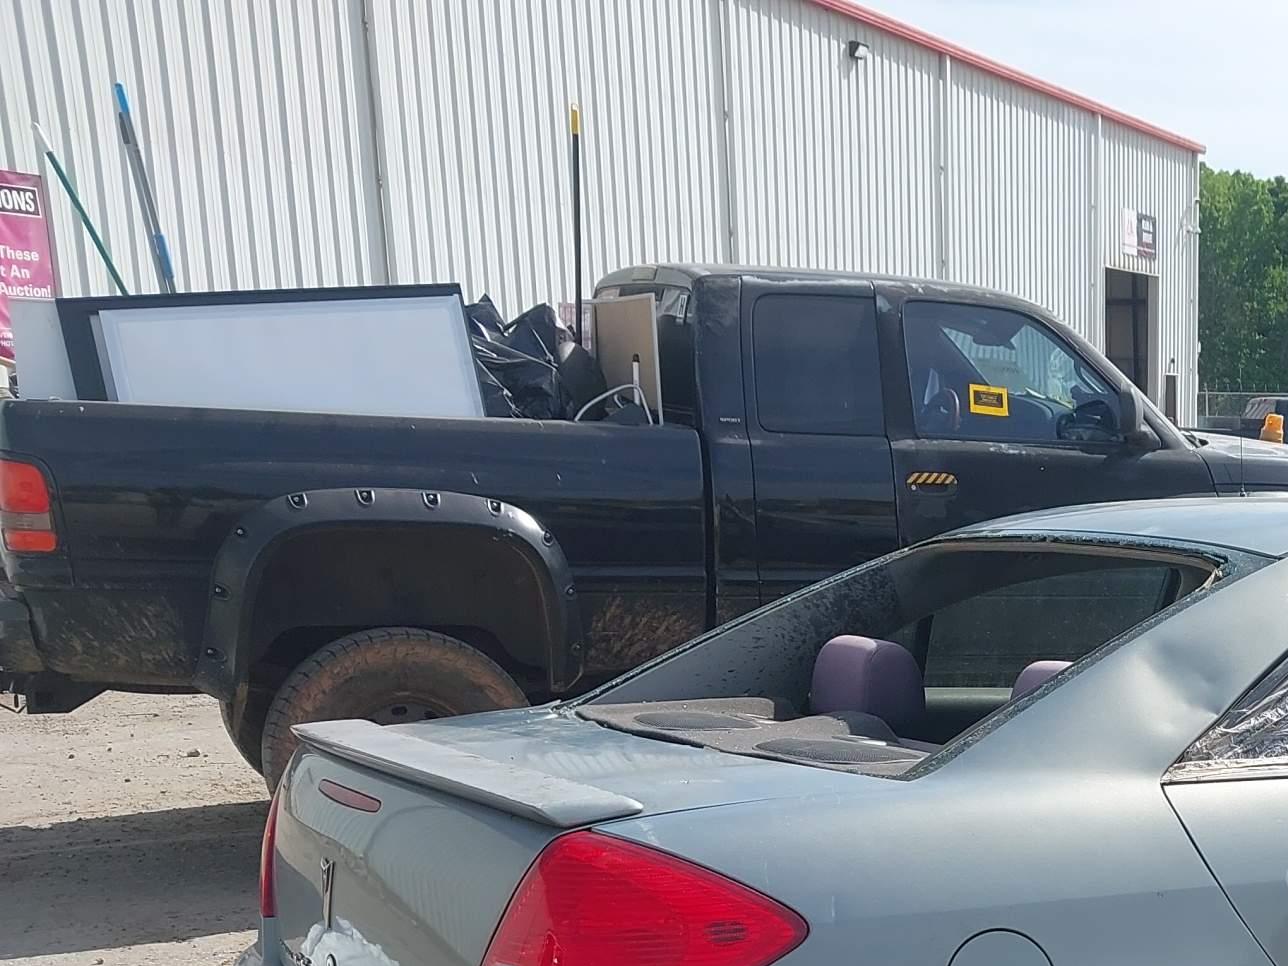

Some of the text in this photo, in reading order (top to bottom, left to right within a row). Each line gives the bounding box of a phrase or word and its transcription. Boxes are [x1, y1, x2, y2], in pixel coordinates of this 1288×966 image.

[0, 188, 35, 212] ONS
[0, 245, 39, 261] These
[10, 264, 30, 279] An
[0, 281, 52, 298] Auction!
